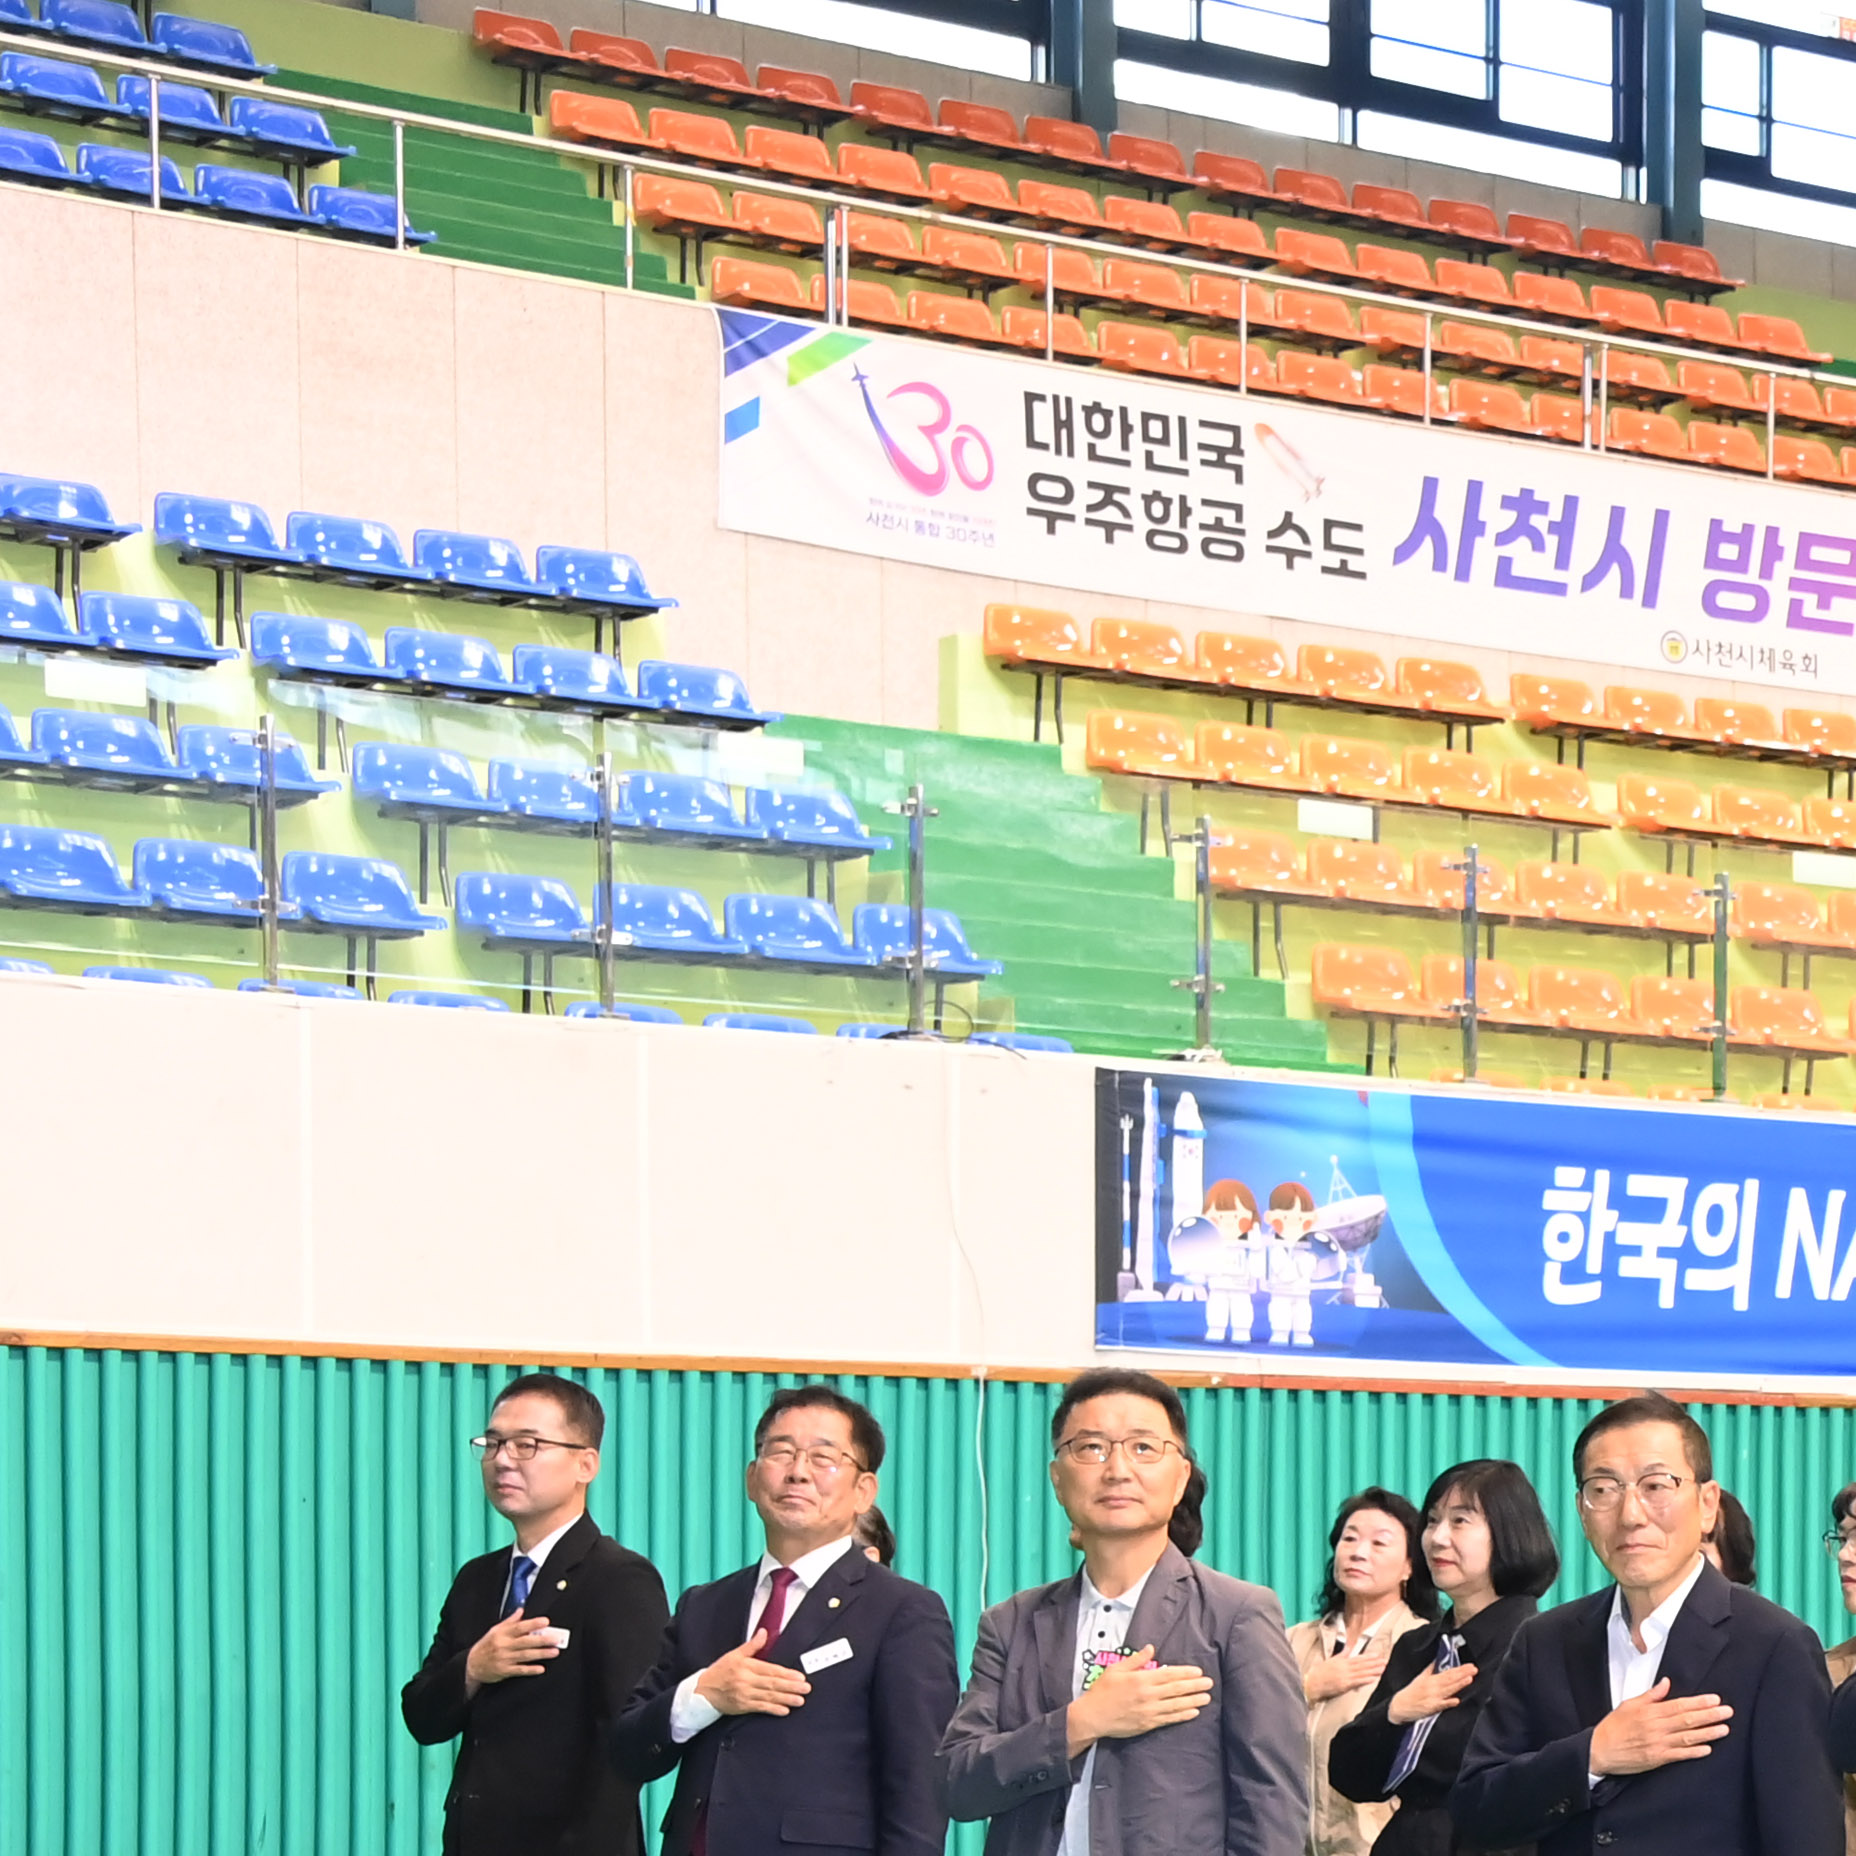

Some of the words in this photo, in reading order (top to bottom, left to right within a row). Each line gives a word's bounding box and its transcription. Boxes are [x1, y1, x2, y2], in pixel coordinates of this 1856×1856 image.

[1023, 391, 1246, 484] 대한민국
[1025, 471, 1247, 563] 우주항공
[1265, 512, 1368, 580] 수도
[1392, 476, 1669, 610] 사천시
[1691, 638, 1819, 680] 사천시체육회
[1542, 1166, 1759, 1312] 한국의
